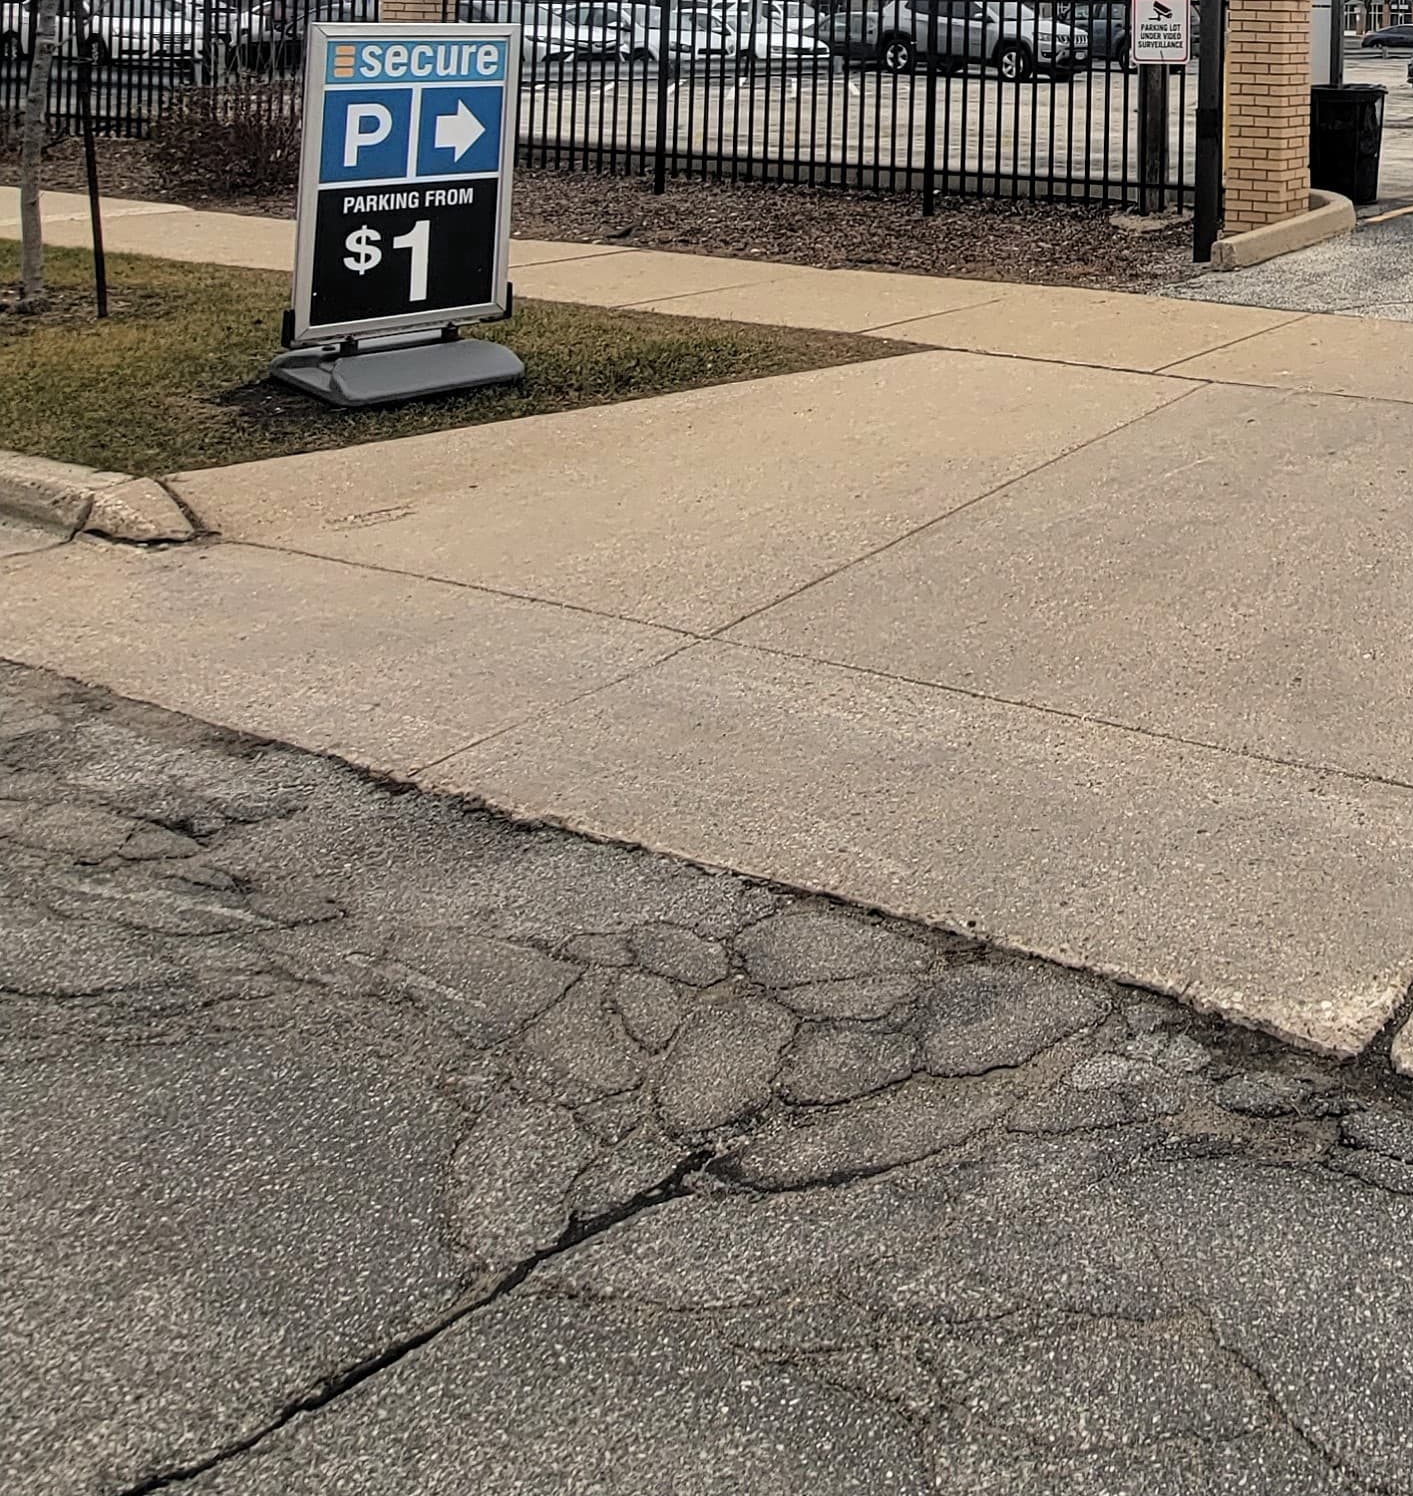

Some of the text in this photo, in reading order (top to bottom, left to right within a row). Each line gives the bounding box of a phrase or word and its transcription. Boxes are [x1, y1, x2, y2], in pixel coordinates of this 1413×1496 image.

[1140, 24, 1181, 32] PARKING LOT
[1140, 32, 1182, 40] UNDER VIDEO
[1138, 41, 1184, 49] SURVEILLANCE
[360, 44, 498, 78] secure
[343, 103, 393, 167] P
[343, 187, 474, 214] PARKING FROM
